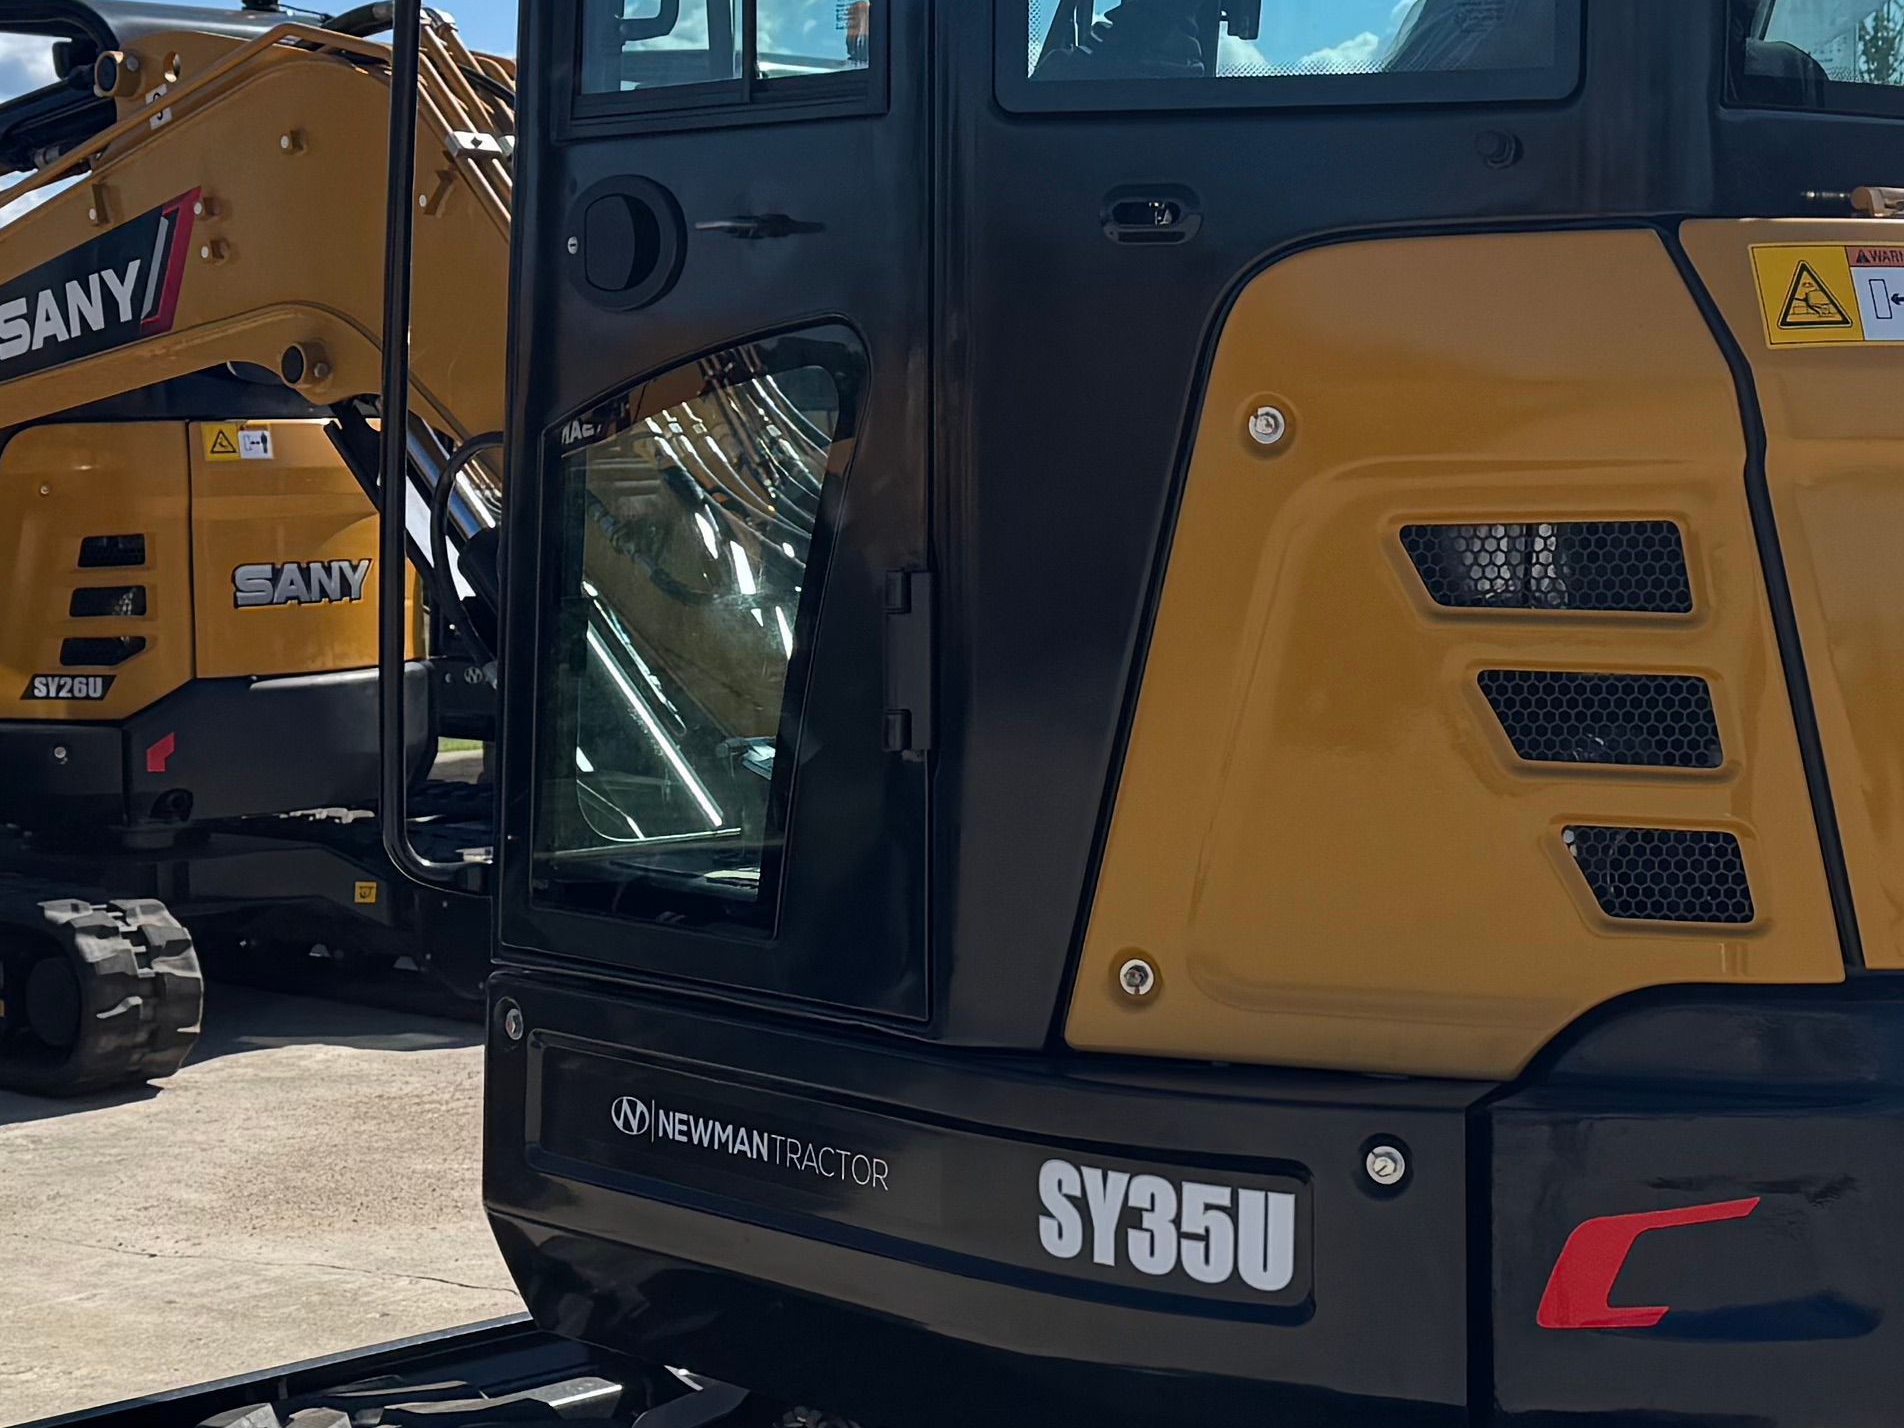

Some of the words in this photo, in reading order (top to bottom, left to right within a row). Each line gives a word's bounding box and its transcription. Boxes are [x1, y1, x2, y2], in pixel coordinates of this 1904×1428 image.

[233, 559, 372, 608] SANY
[33, 676, 103, 698] SY26U
[1038, 1158, 1296, 1292] SY35U
